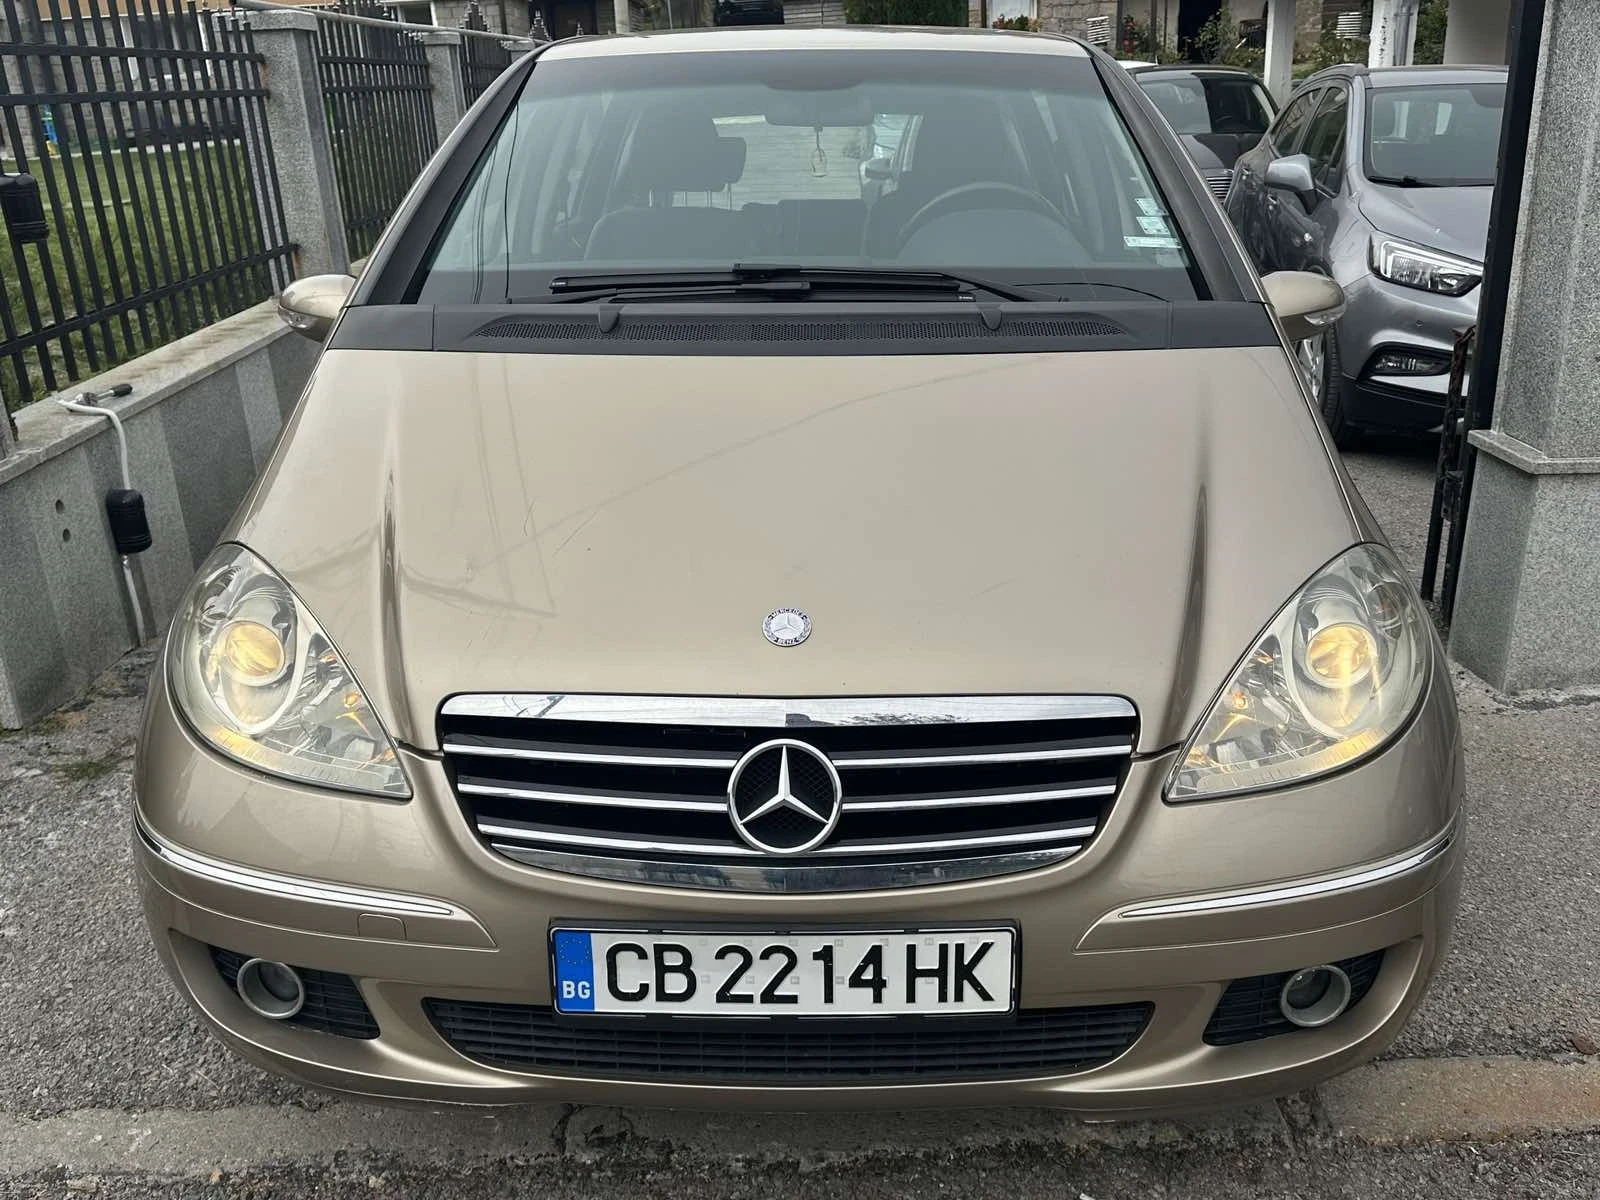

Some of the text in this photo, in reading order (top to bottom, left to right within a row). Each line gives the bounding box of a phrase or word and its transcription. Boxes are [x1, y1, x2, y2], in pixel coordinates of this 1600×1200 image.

[563, 981, 591, 999] BG
[606, 942, 995, 1004] CB 2214 HK
